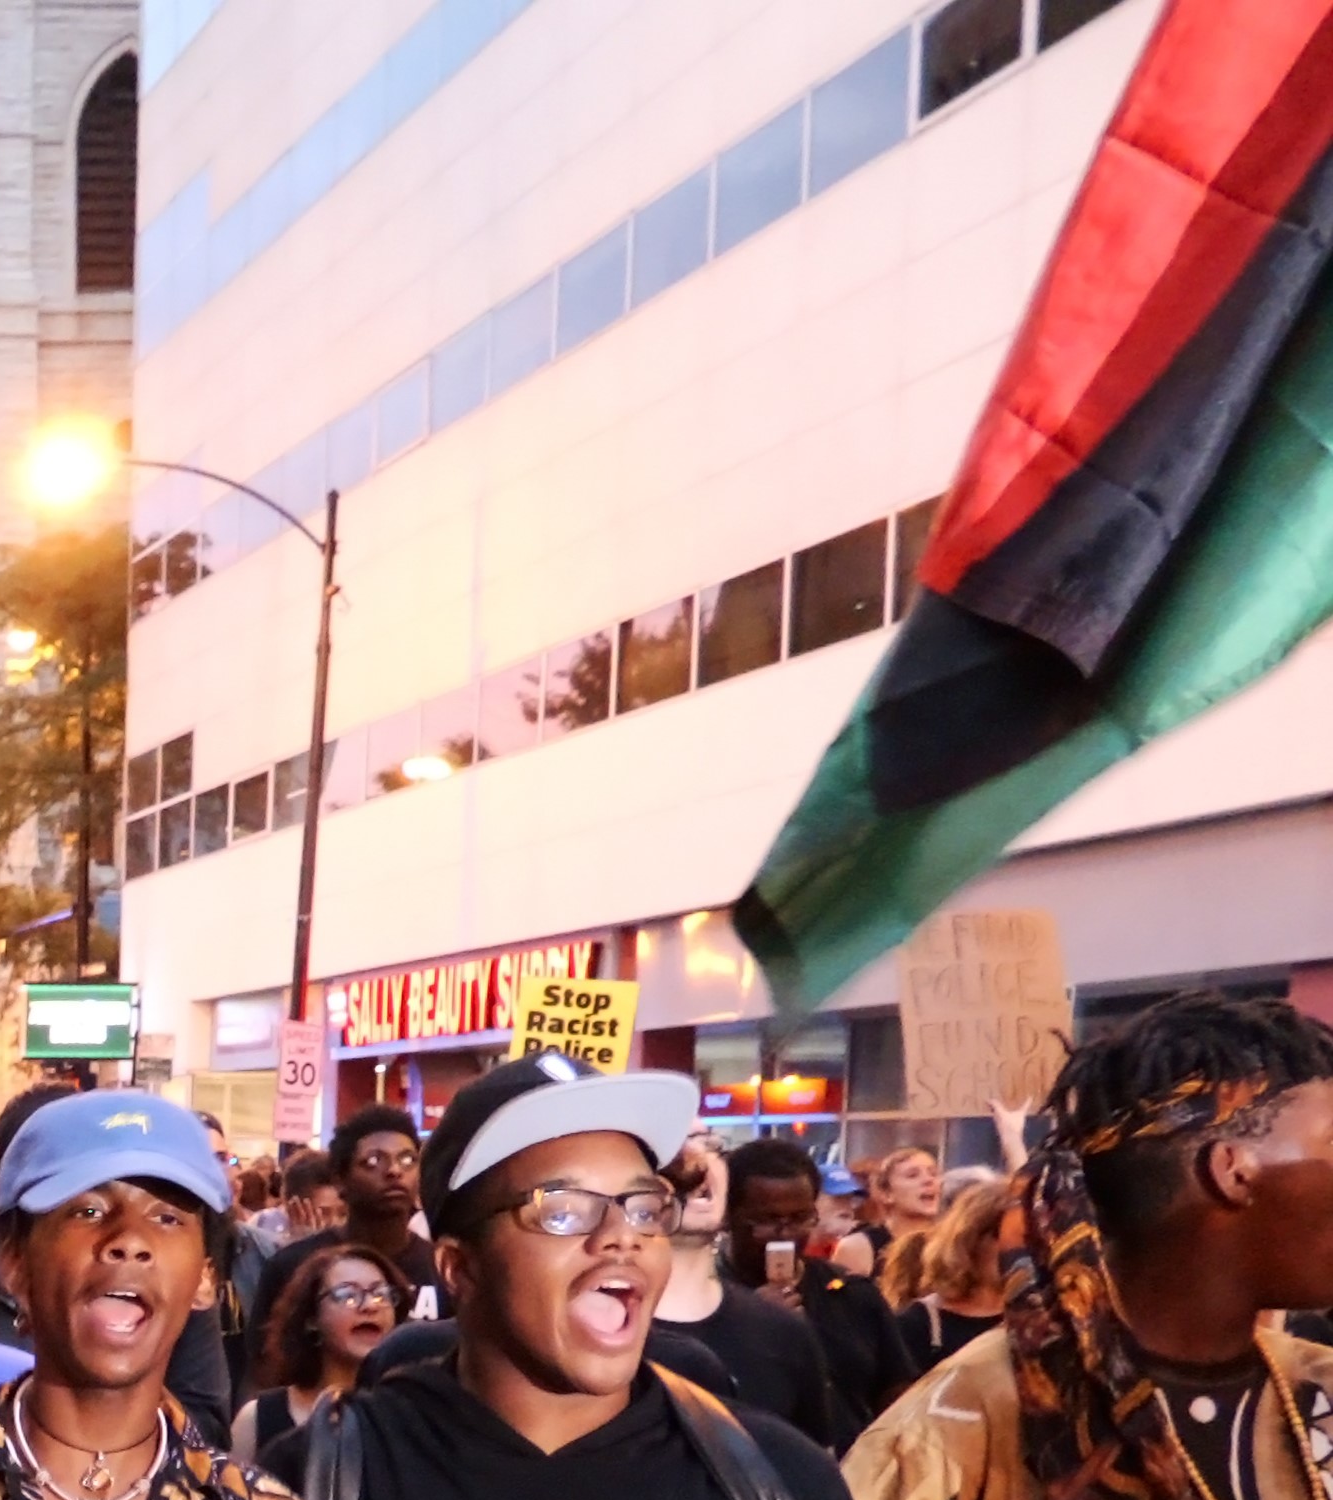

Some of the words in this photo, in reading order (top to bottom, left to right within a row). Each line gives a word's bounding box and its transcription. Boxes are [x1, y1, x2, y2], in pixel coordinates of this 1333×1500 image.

[347, 975, 405, 1046] SALLY
[407, 958, 492, 1040] BEAUTY
[542, 985, 611, 1018] Stop
[526, 1011, 619, 1037] Racist
[284, 1060, 316, 1087] 30
